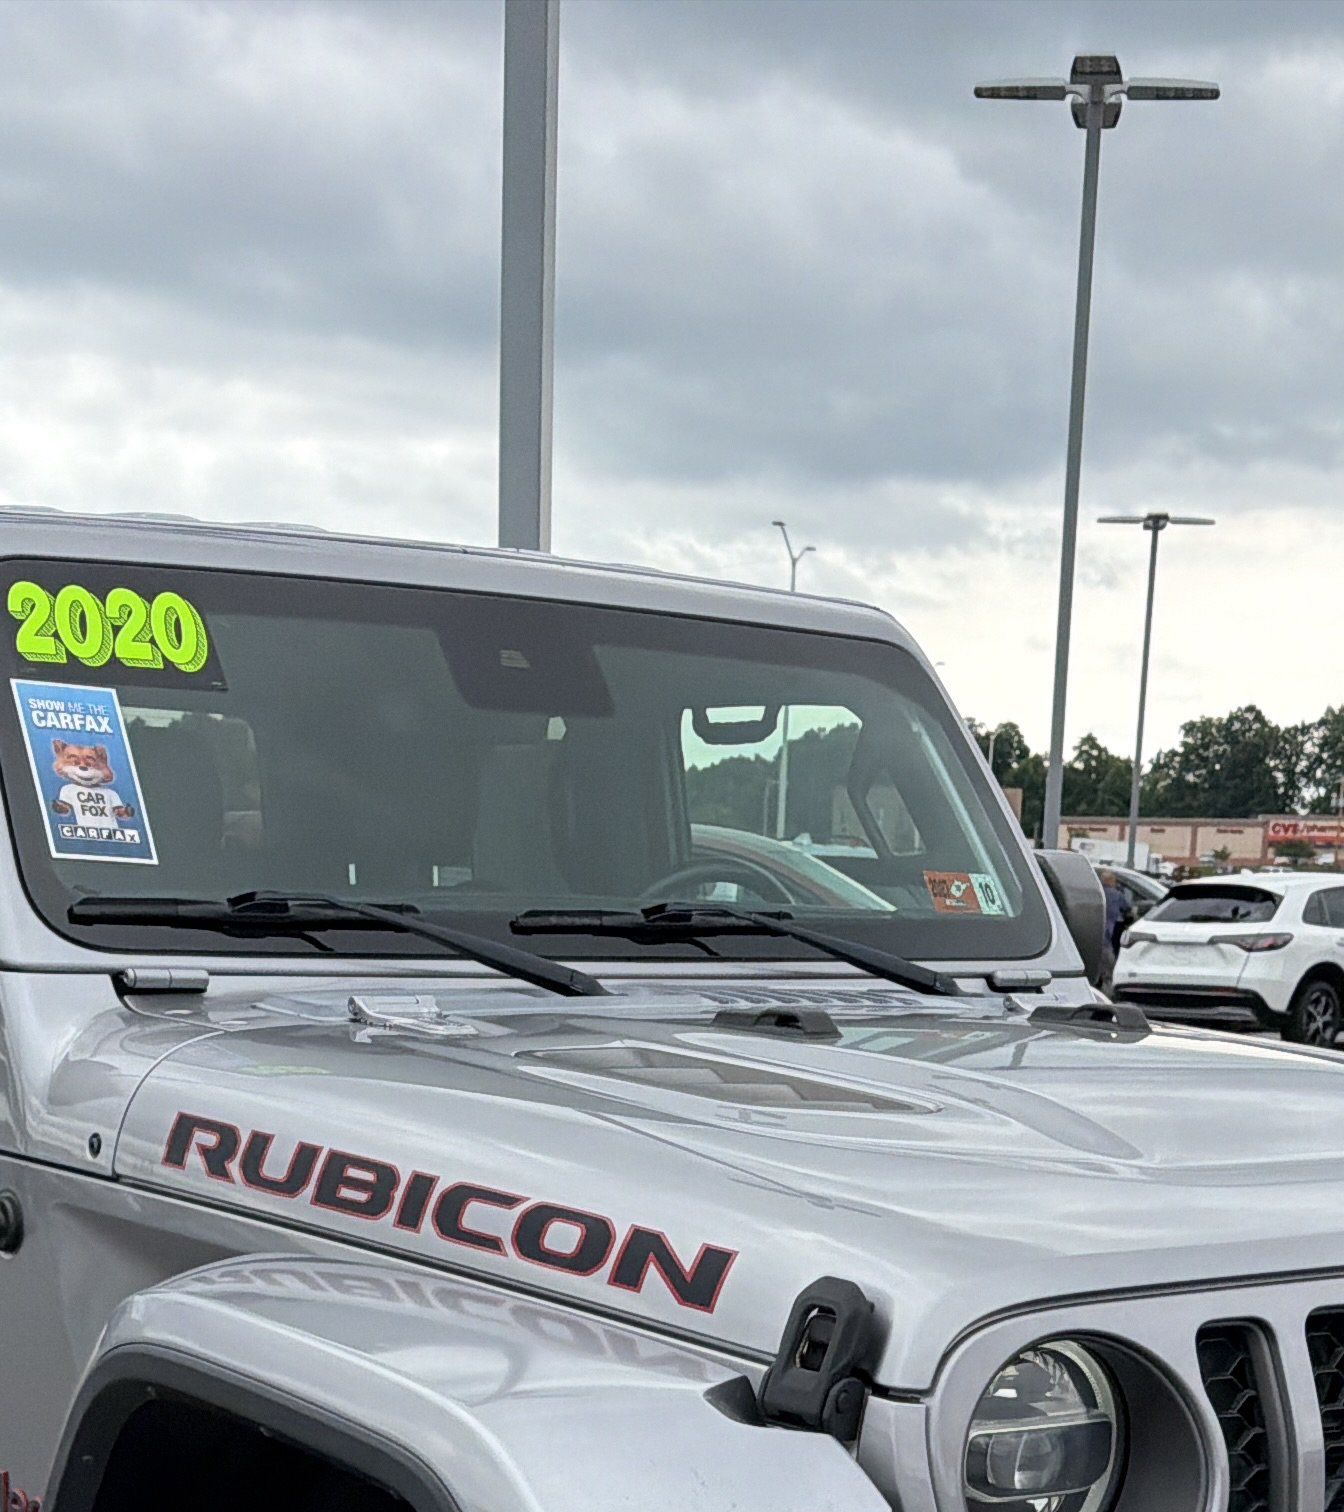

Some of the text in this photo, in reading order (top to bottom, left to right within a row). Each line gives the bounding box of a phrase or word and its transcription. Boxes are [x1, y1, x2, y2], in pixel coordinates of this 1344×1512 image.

[7, 581, 208, 673] 2020
[28, 697, 110, 716] SHOW ME THE
[30, 709, 114, 734] CARFAX
[76, 791, 106, 805] CAR
[80, 804, 109, 818] FOX
[60, 825, 138, 843] CARFAX
[160, 1111, 740, 1314] RUBICON
